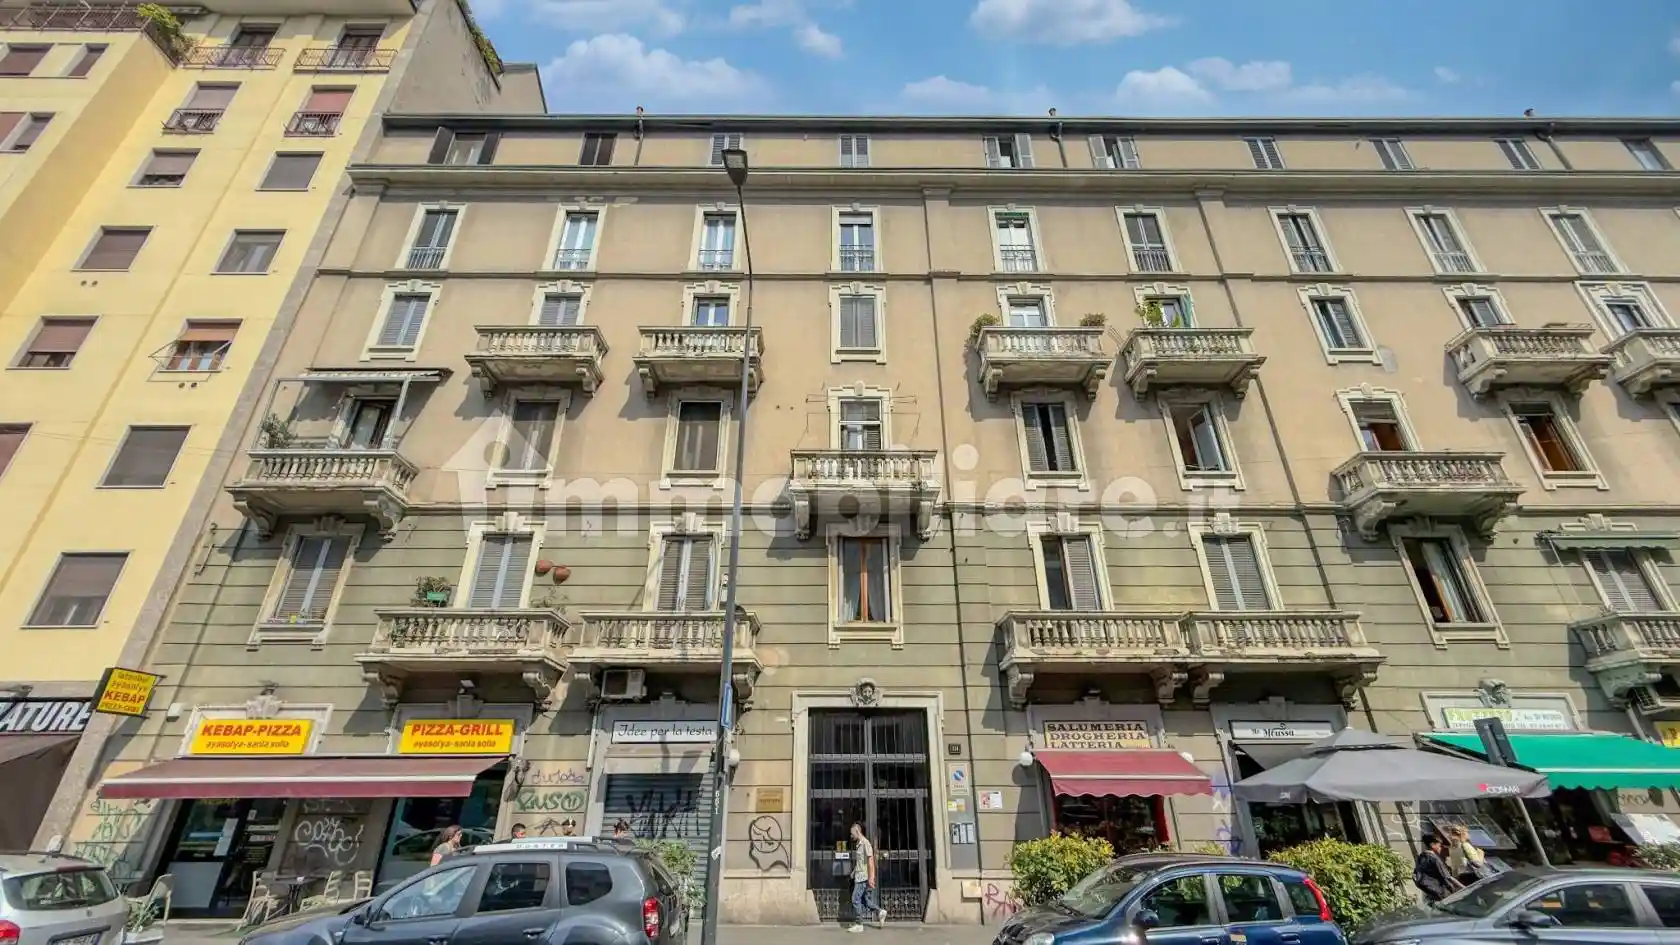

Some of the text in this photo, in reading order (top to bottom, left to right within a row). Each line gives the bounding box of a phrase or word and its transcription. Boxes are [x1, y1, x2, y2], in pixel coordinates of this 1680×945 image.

[104, 690, 145, 703] KEBAP
[202, 725, 301, 736] KEBAP-PIZZA
[411, 724, 503, 736] PIZZA-GRILL
[618, 723, 712, 741] Idee per la testa
[1047, 723, 1144, 731] SALUMERIA
[1050, 732, 1146, 740] DROGHERIA
[1050, 741, 1124, 749] LATTERIA
